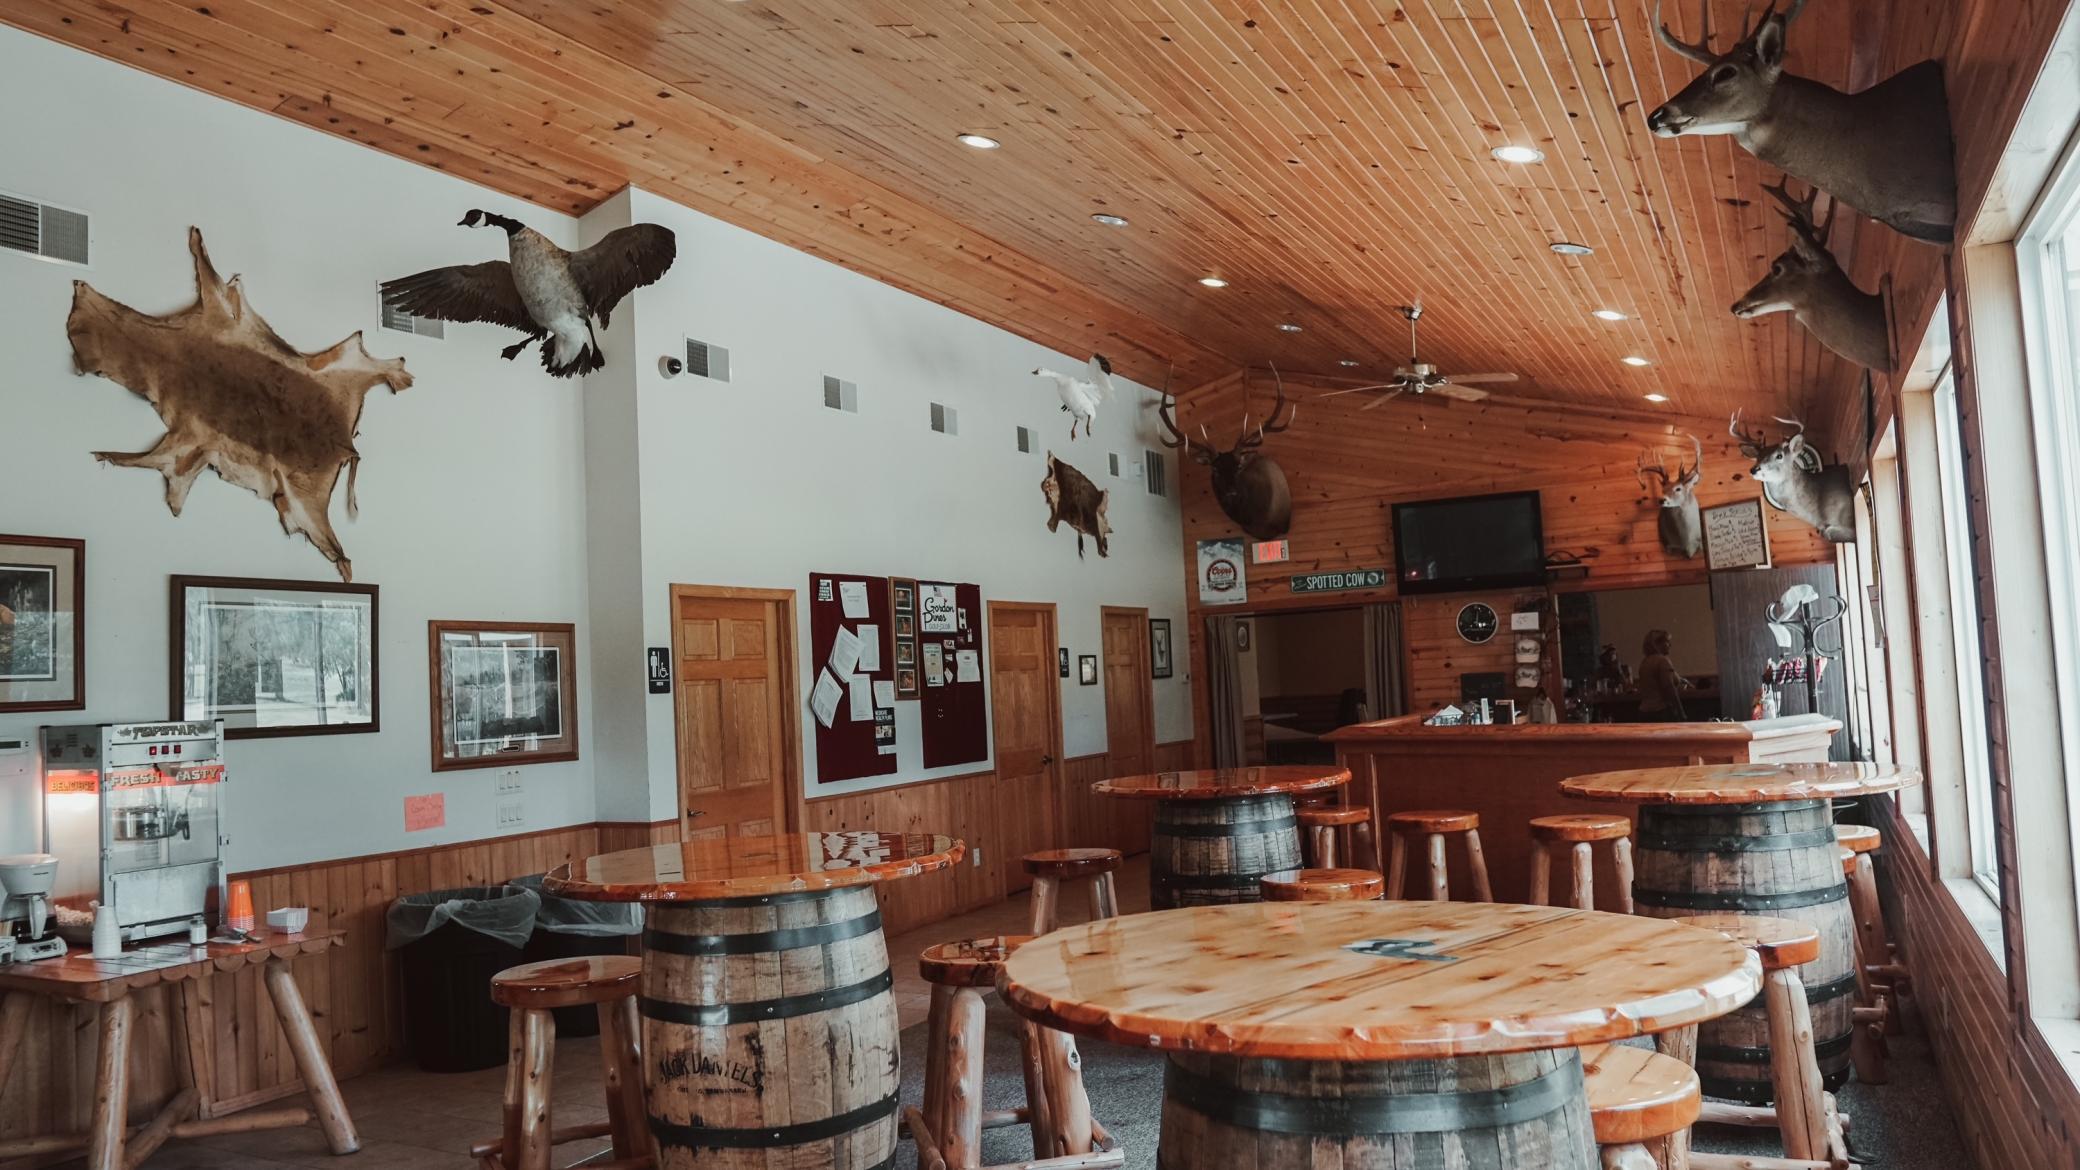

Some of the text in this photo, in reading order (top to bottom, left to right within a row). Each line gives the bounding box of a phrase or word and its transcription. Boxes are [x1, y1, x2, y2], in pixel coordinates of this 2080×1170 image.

[1306, 572, 1366, 590] SPOTTED COW
[925, 597, 955, 613] Gordon
[111, 772, 162, 788] FRESH
